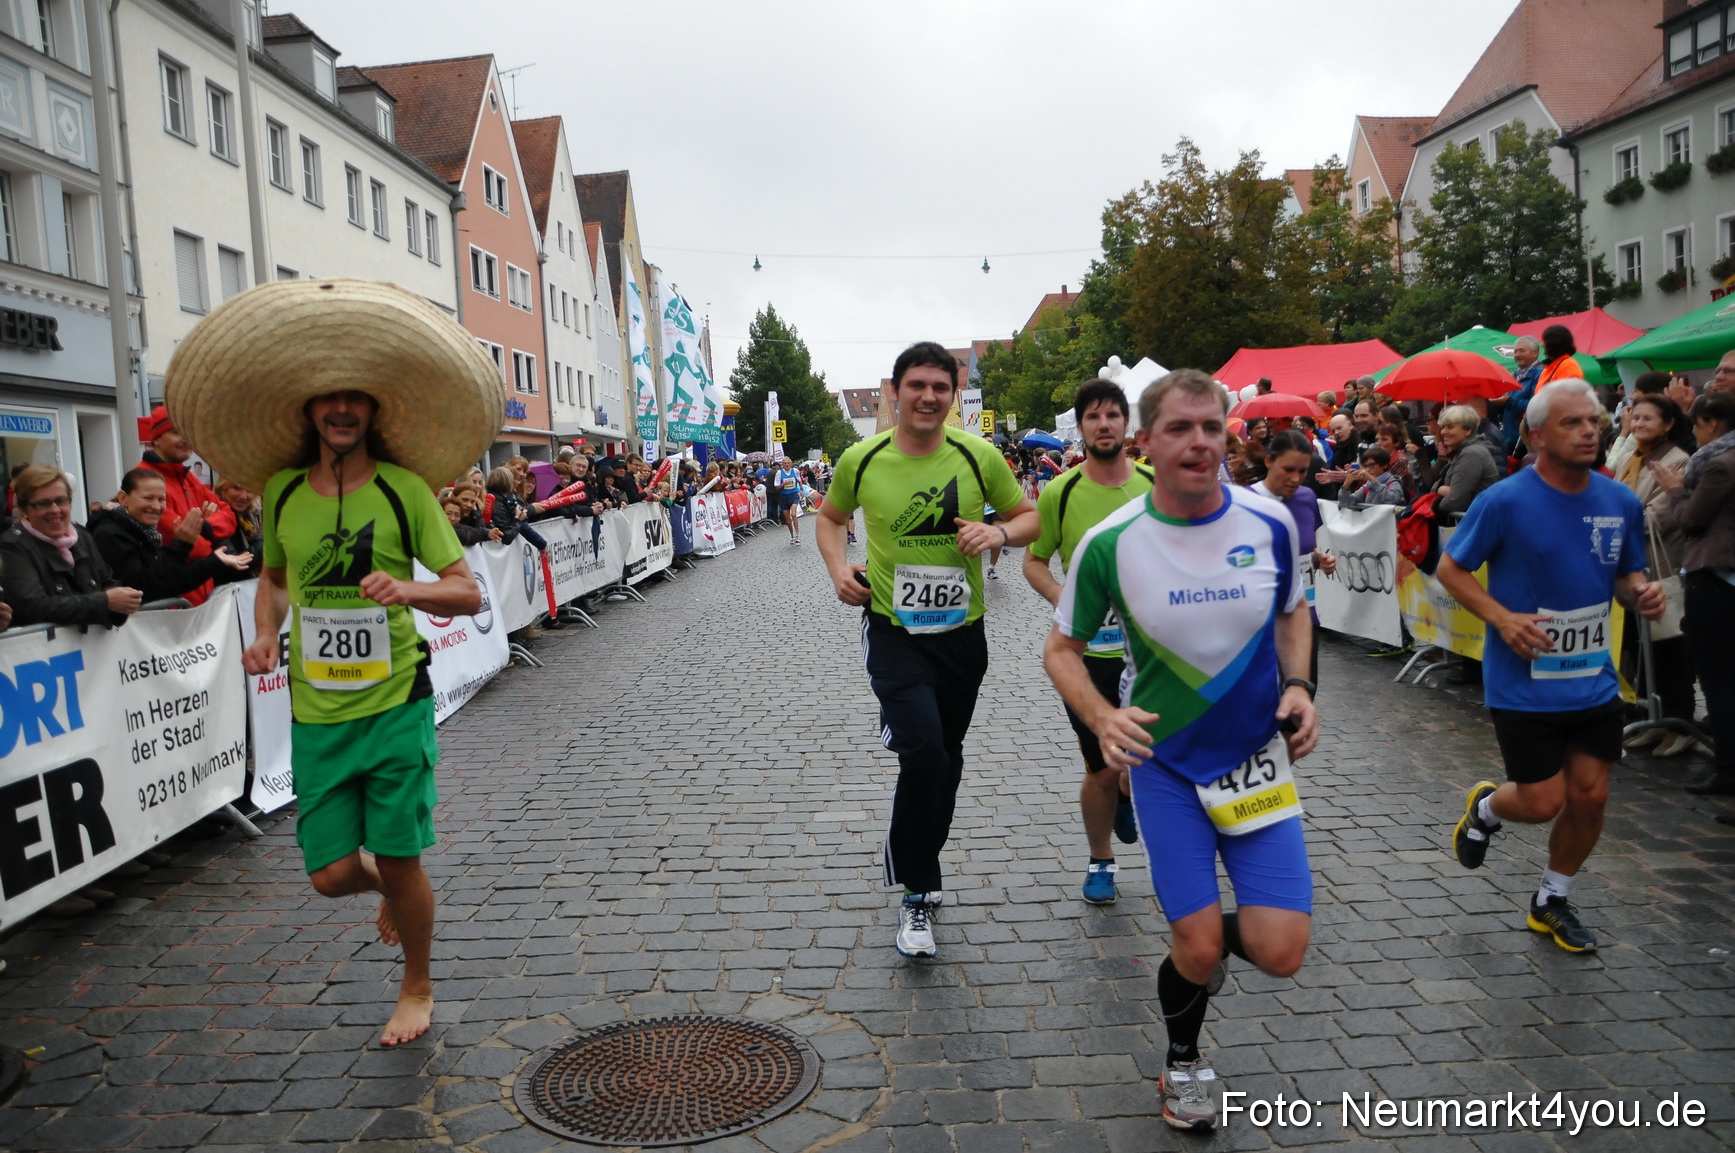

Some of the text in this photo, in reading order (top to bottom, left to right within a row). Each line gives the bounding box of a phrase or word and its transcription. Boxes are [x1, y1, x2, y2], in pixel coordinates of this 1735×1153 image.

[17, 417, 50, 433] WEBER
[775, 427, 783, 438] B
[983, 417, 991, 428] B
[889, 500, 923, 533] GOSSEN
[898, 536, 957, 548] METRAWAT
[299, 542, 331, 581] GOSSEN
[897, 570, 957, 581] PARTL Neumarkt
[304, 590, 361, 600] METRAWA
[901, 582, 964, 608] 2462
[1169, 584, 1246, 606] Michael
[303, 615, 373, 626] PARTL Neumarkt
[913, 614, 947, 624] Roman
[318, 628, 372, 659] 280
[1545, 621, 1605, 653] 2014
[118, 642, 218, 684] Kastengasse
[328, 666, 362, 678] Armin
[1560, 659, 1588, 669] Klaus
[125, 689, 209, 733] Im Herzen
[131, 717, 206, 765] der Stadt
[138, 741, 245, 812] 92318 Neumarkt
[1218, 749, 1276, 793] 425
[1233, 790, 1283, 820] Michael
